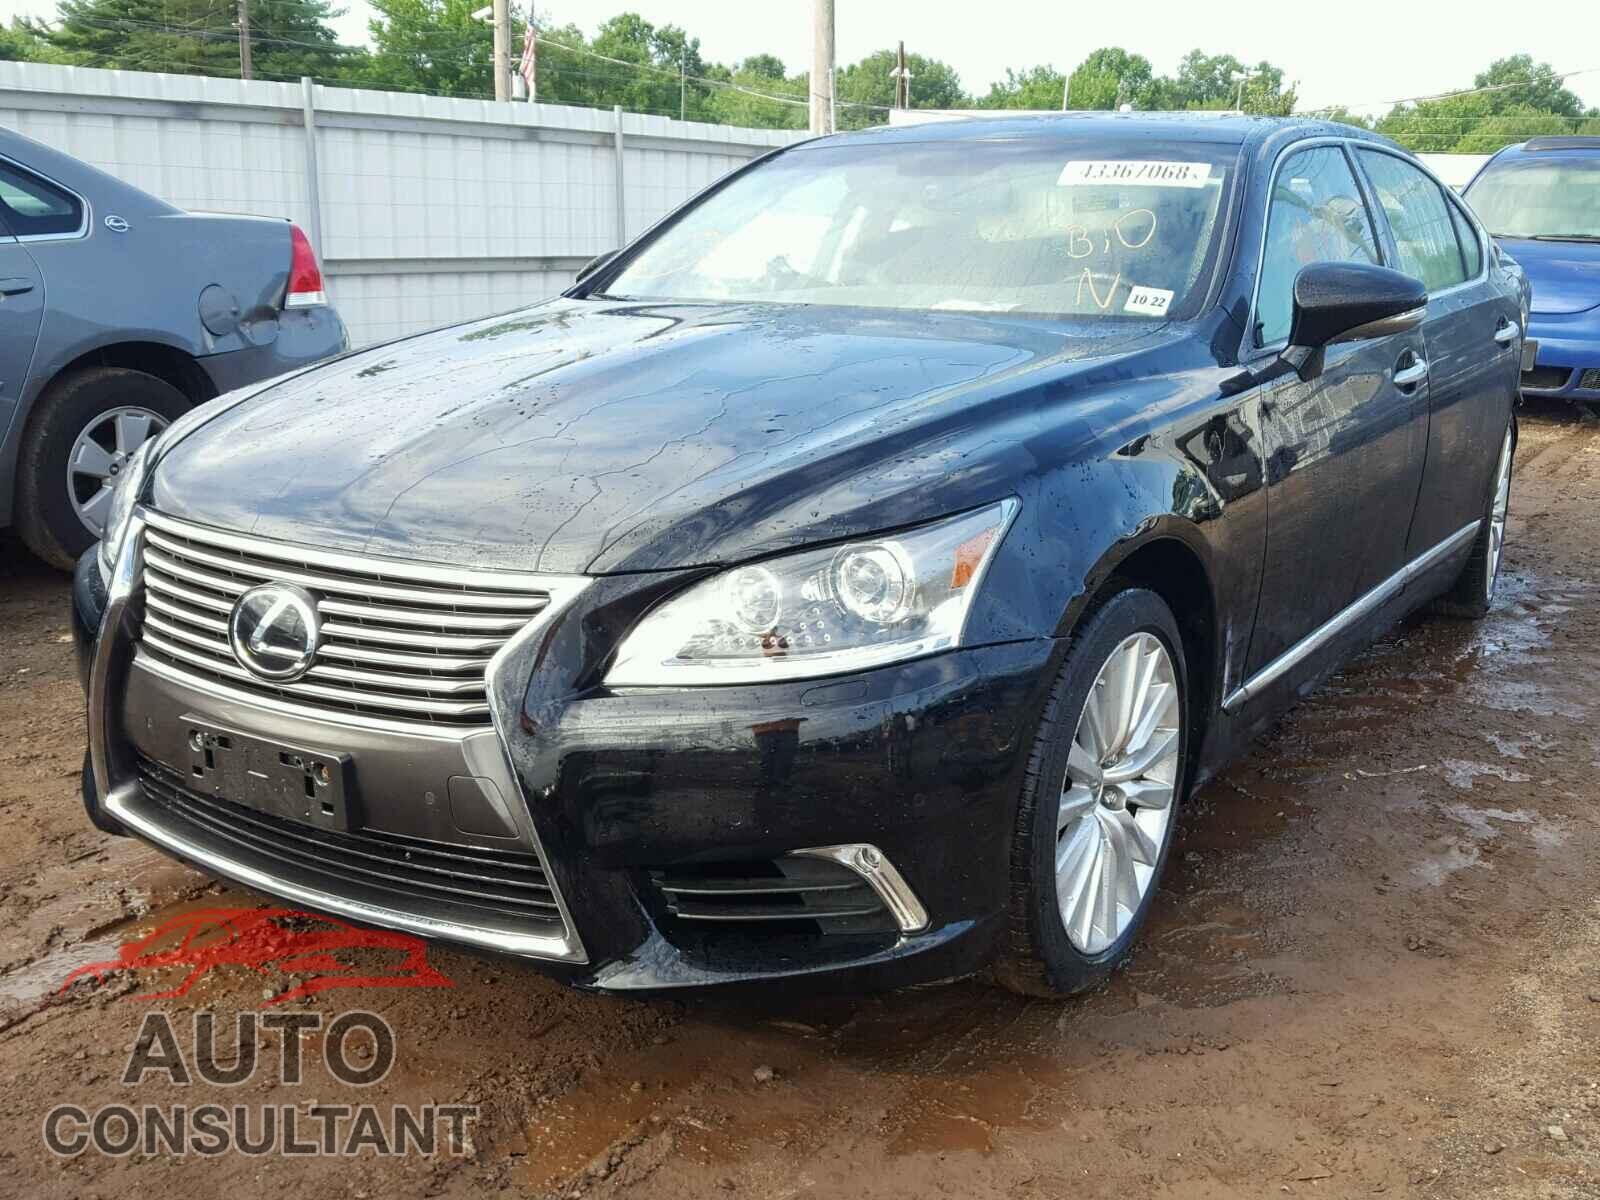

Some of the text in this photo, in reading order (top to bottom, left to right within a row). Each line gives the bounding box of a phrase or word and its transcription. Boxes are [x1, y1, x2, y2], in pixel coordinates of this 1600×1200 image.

[1076, 267, 1121, 309] N
[1132, 295, 1166, 308] 10 22
